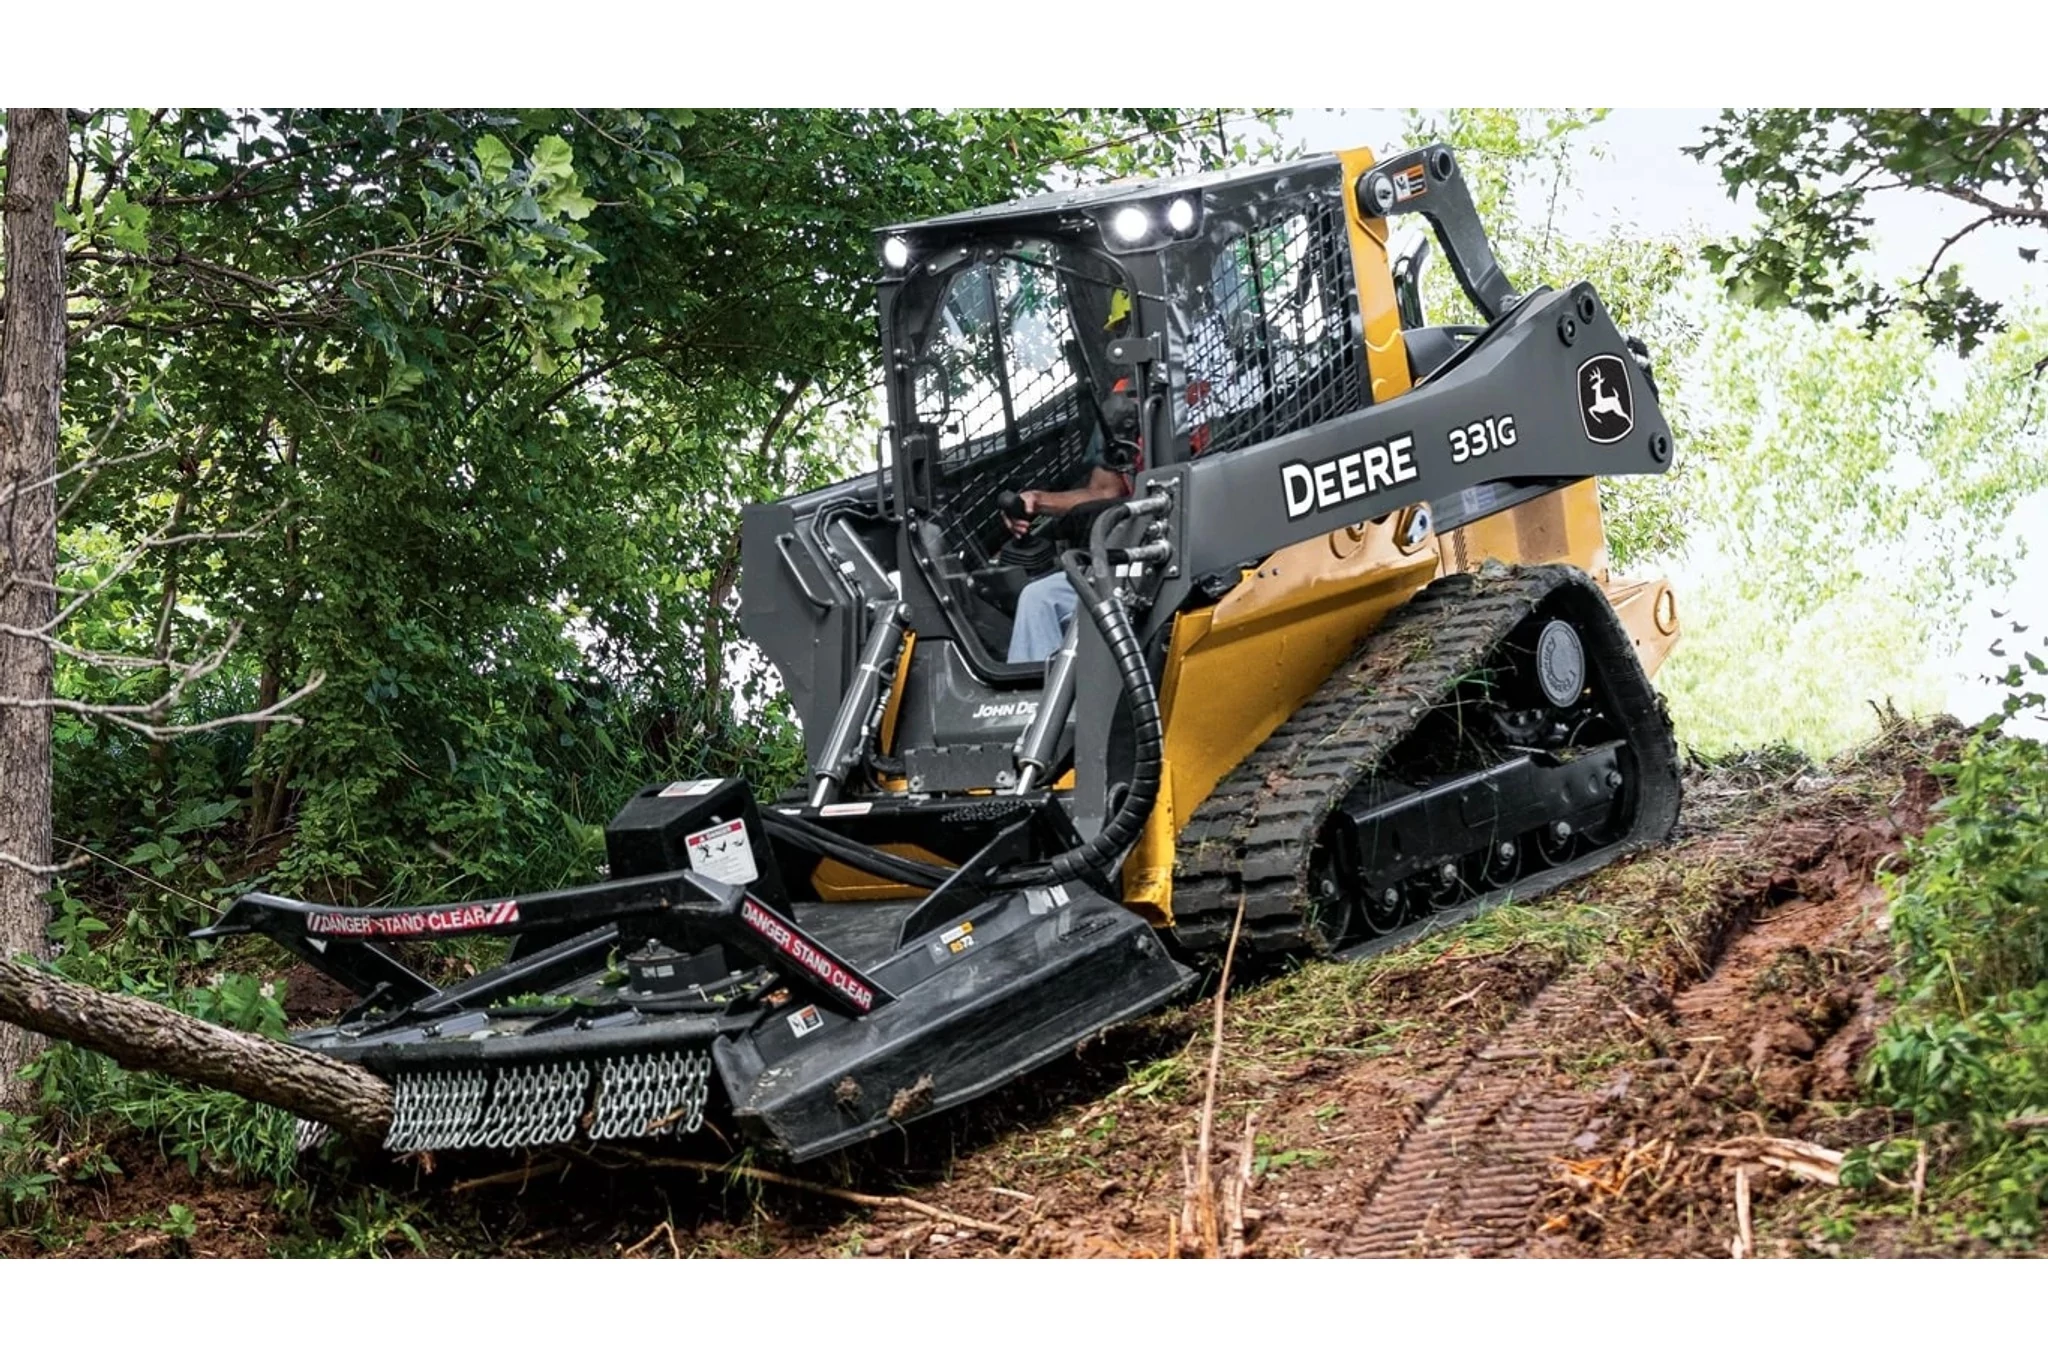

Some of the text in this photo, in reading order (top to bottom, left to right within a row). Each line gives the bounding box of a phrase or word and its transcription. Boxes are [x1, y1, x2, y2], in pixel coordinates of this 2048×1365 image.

[1282, 417, 1516, 517] DEERE 331G
[973, 704, 1015, 718] JOHN
[322, 914, 371, 933] DANGER
[428, 907, 488, 930] CLEAR
[741, 900, 873, 1011] DANGER STAND CLEAR
